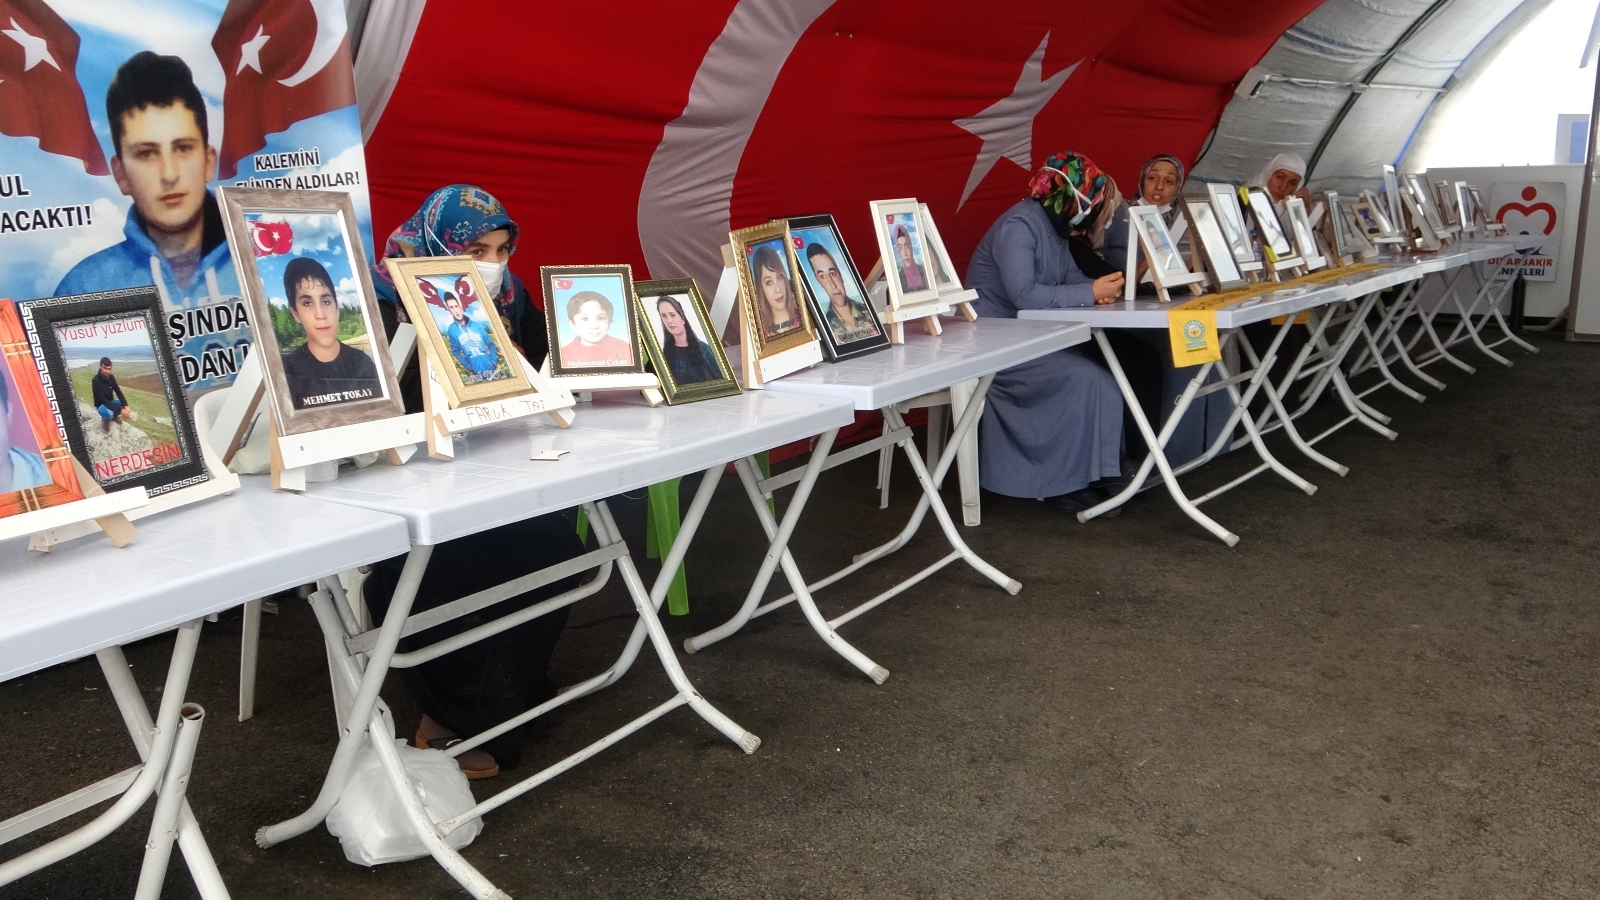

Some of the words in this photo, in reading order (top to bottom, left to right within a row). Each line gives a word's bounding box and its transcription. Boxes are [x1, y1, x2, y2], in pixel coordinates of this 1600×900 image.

[255, 148, 320, 171] KALEMİNİ
[0, 175, 30, 198] UL
[295, 171, 360, 190] ALDILAR!
[1, 205, 92, 234] ACAKTI!
[1498, 267, 1546, 276] NNELERİ
[59, 321, 98, 341] Yusuf
[100, 317, 147, 339] yüzlüm
[168, 302, 250, 347] ŞINDA
[566, 358, 606, 367] Muhammed
[302, 392, 342, 406] MEHMET
[342, 388, 373, 401] TOKAY
[465, 404, 513, 428] FARUK
[94, 441, 180, 479] NERDESİN
